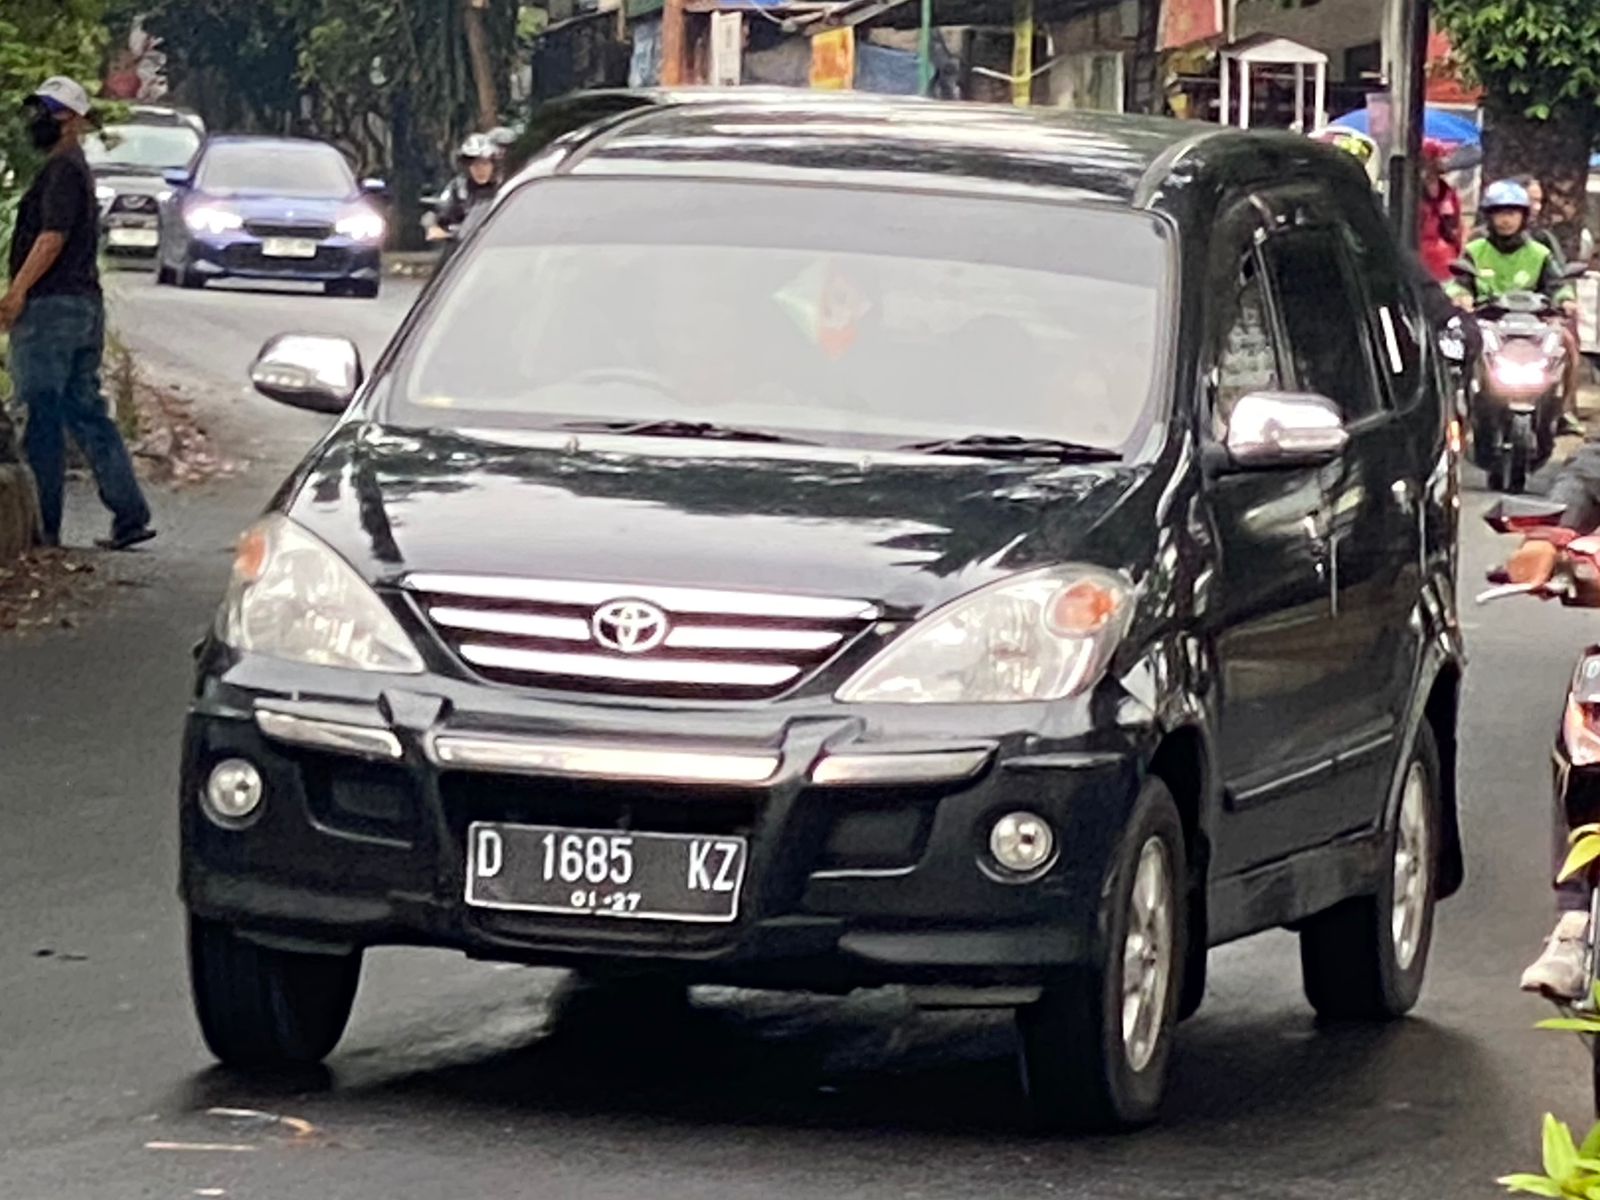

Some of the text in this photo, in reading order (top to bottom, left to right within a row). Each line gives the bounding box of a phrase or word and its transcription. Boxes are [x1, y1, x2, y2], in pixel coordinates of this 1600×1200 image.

[477, 830, 738, 891] D 1685 KZ
